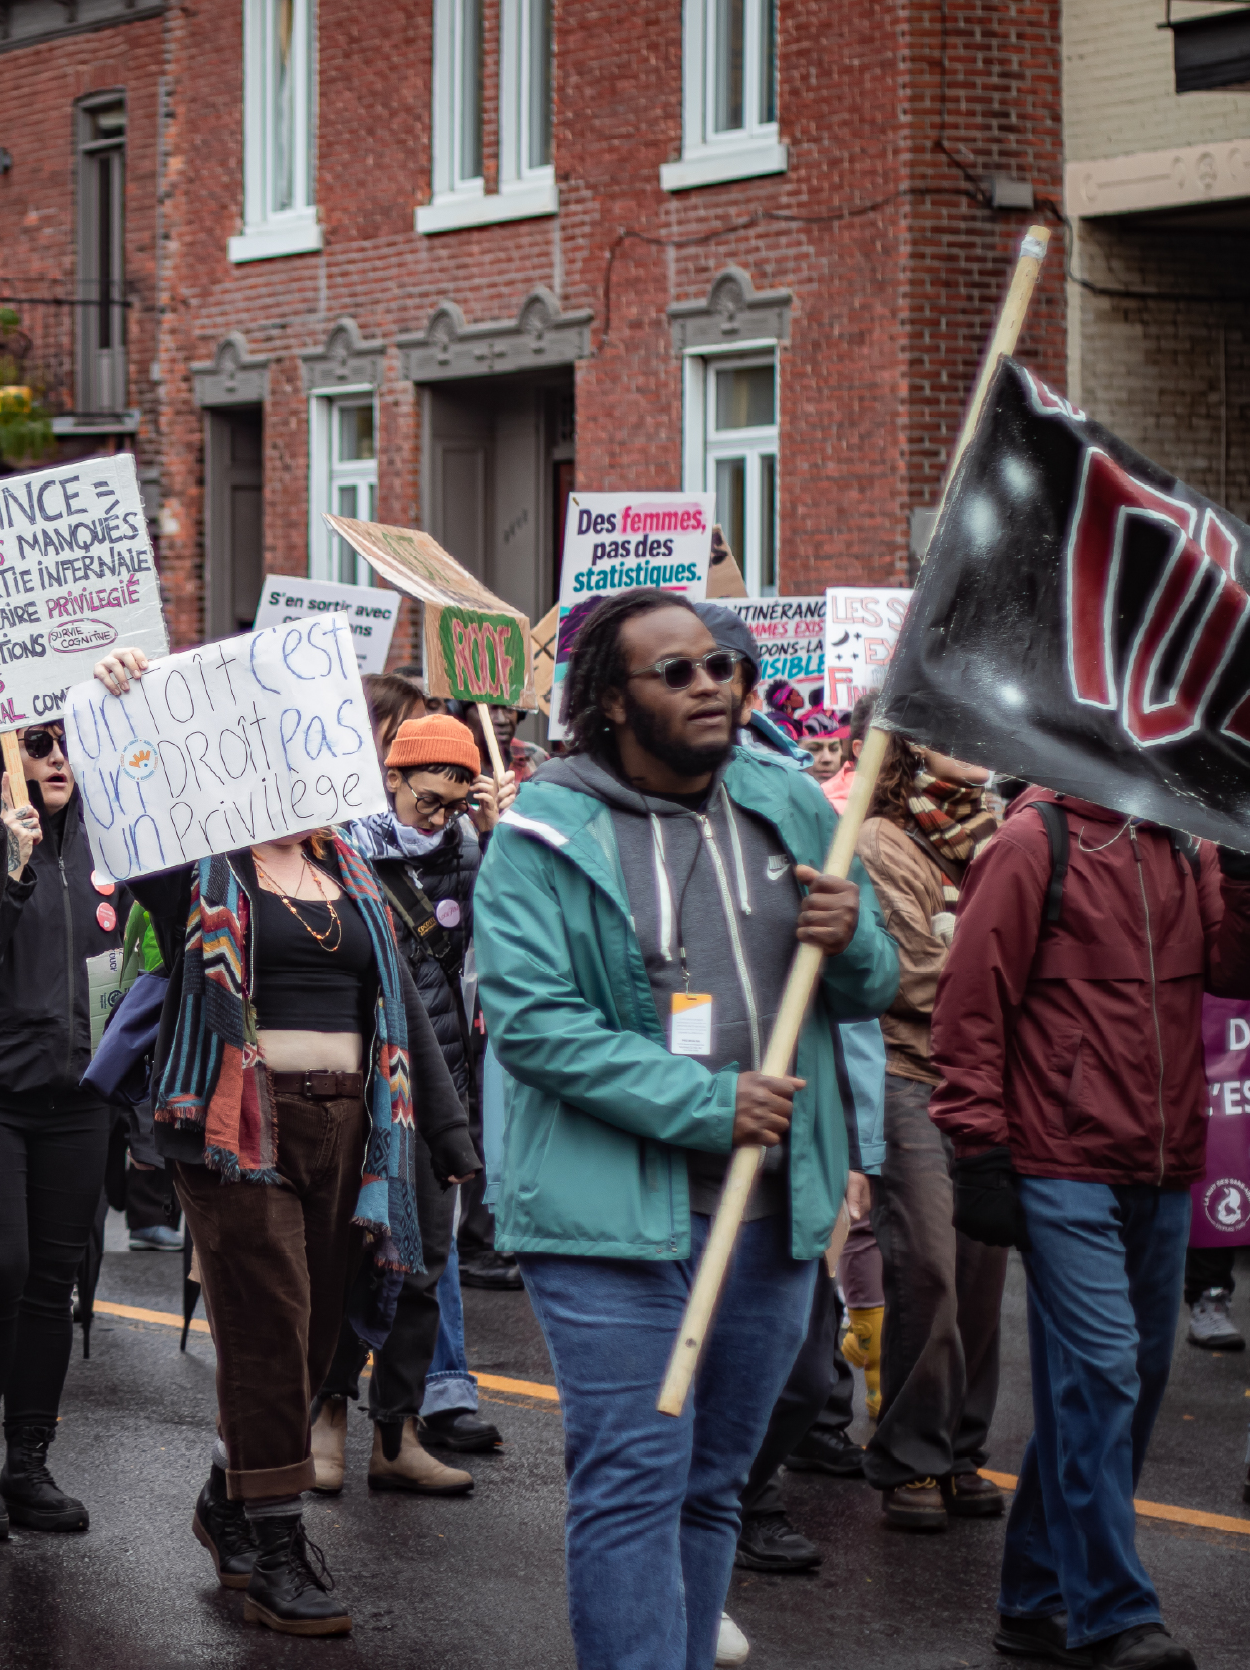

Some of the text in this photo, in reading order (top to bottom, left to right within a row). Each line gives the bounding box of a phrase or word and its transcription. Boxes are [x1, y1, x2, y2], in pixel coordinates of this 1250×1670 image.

[17, 499, 140, 560] MANQUÉS
[578, 505, 707, 535] Des femmes,
[592, 534, 674, 566] pas des
[573, 559, 702, 592] statistiques.
[268, 591, 304, 608] S'en
[355, 604, 392, 620] avec
[50, 626, 84, 642] SURVIE
[453, 619, 512, 700] ROOF
